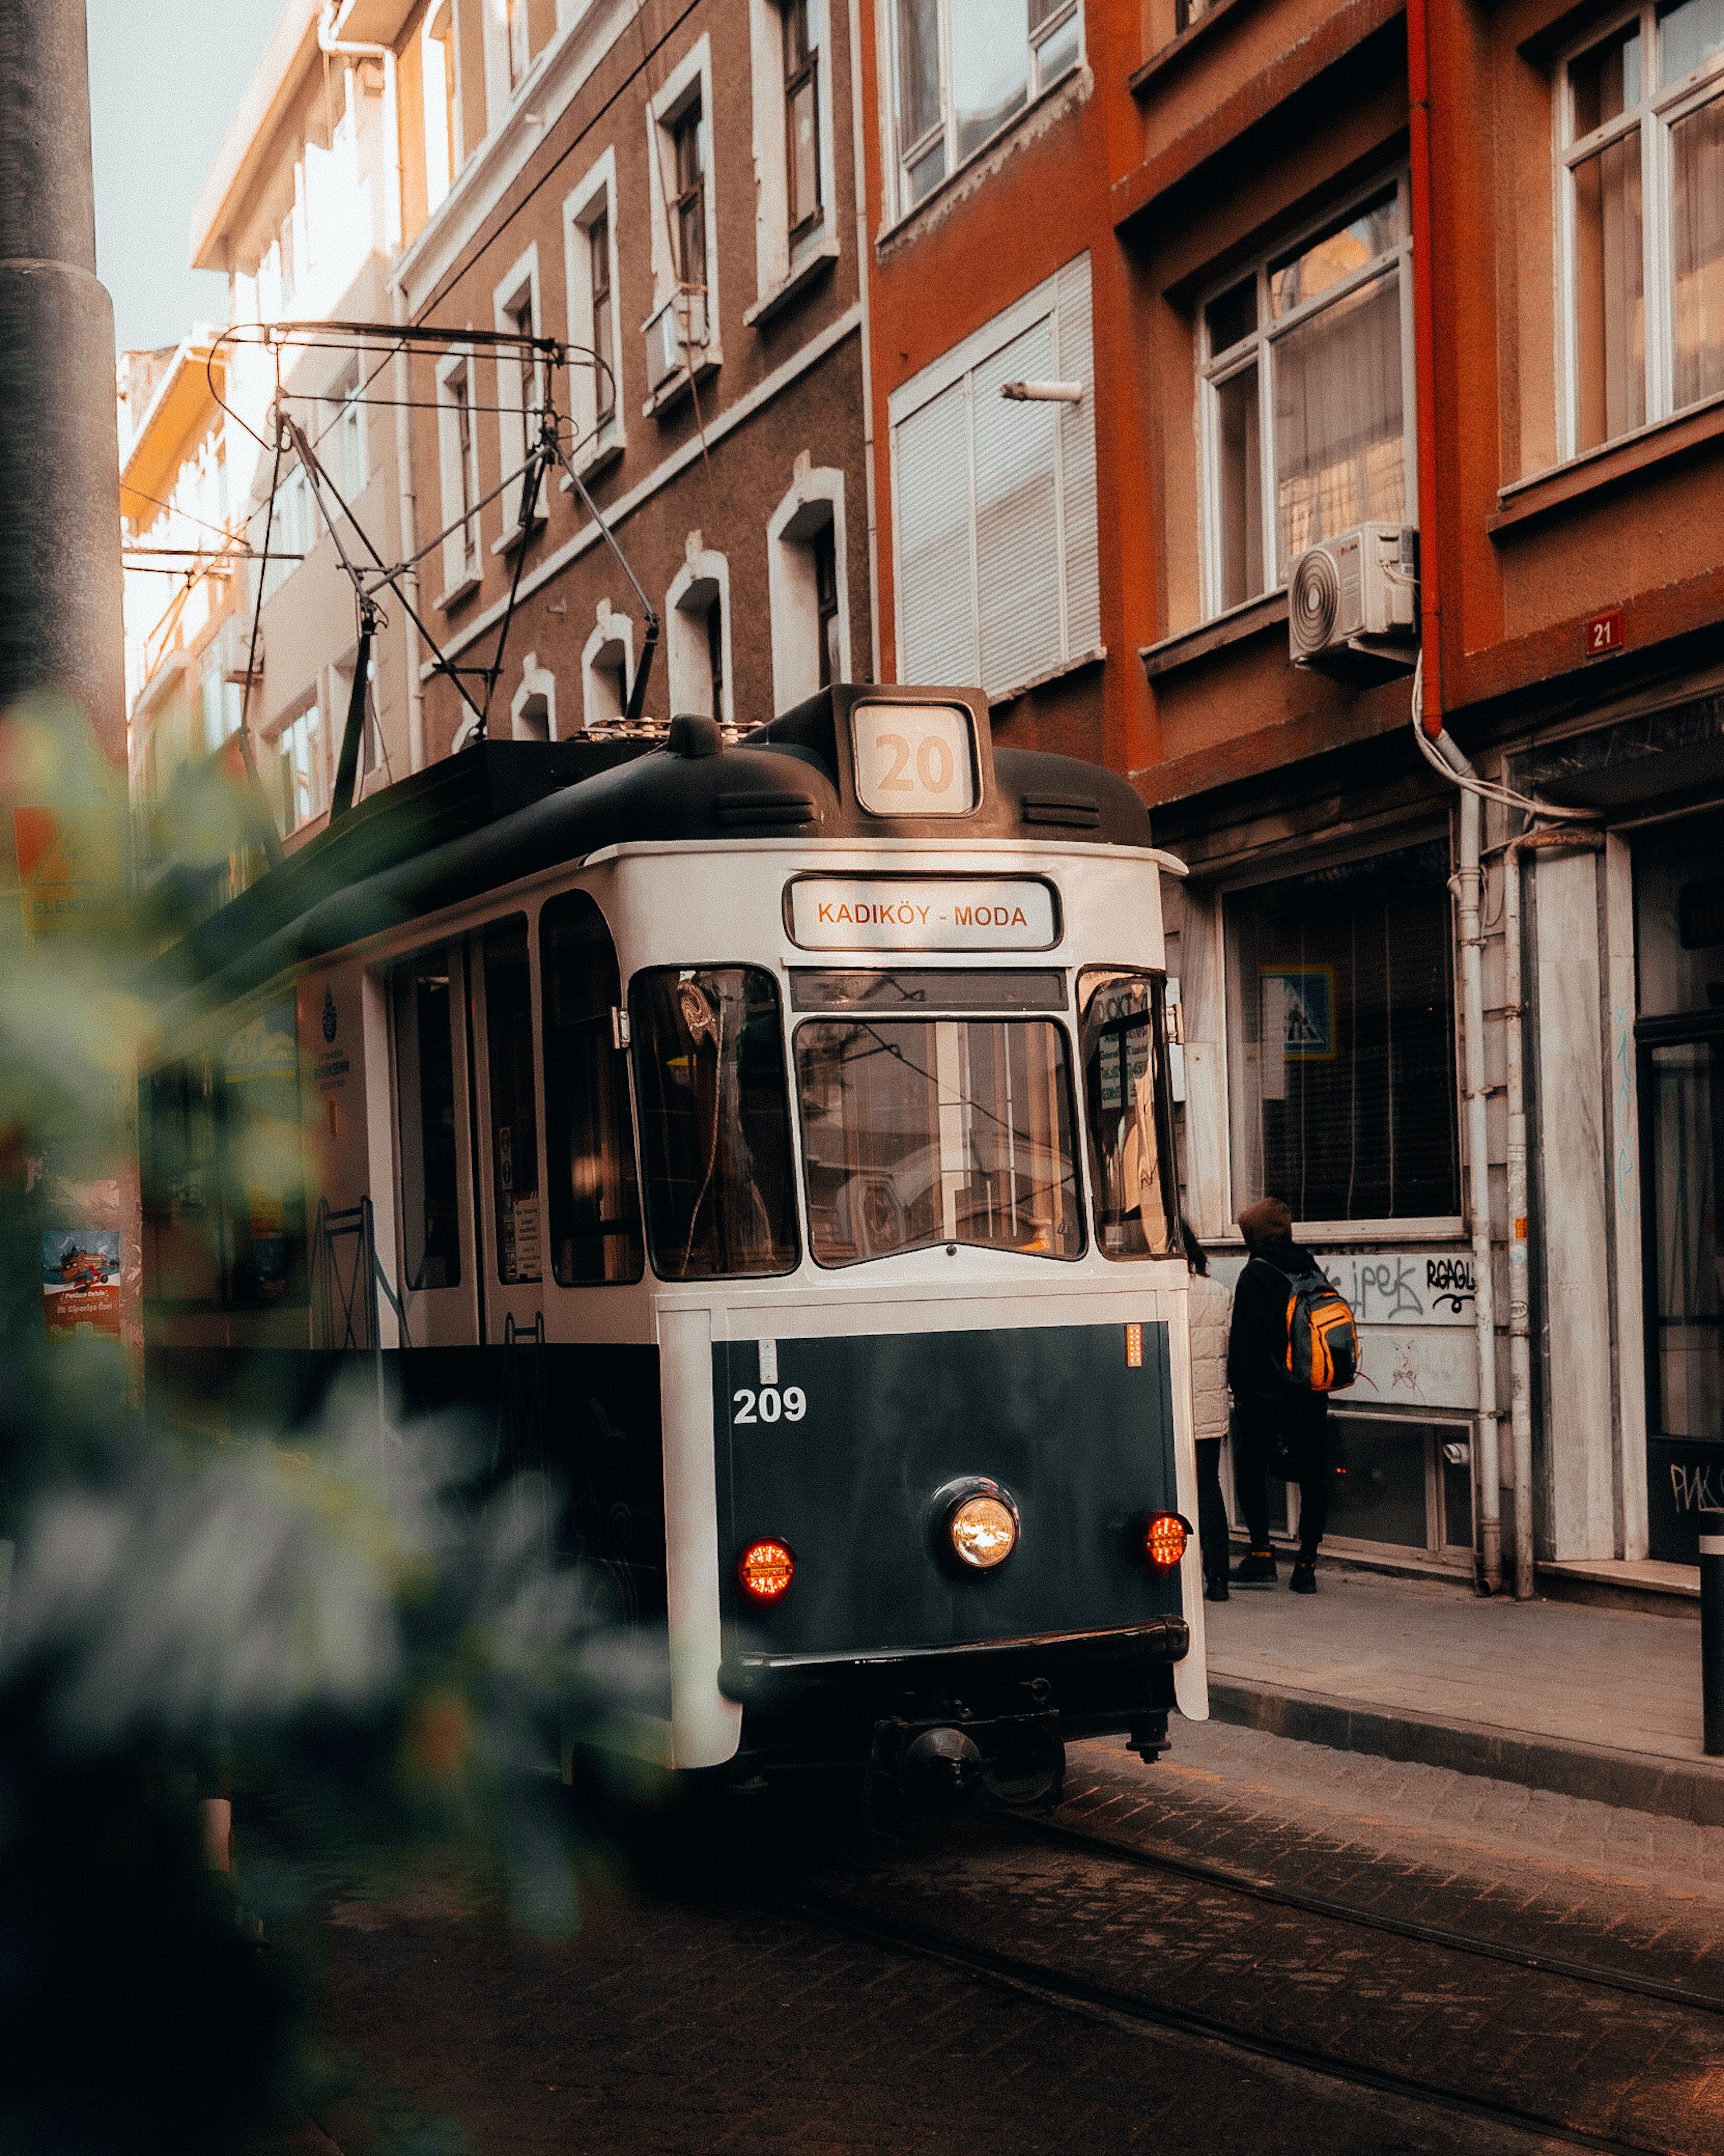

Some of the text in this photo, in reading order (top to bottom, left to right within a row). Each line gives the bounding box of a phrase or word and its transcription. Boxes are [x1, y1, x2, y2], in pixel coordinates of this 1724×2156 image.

[1594, 621, 1611, 647] 21
[875, 734, 954, 794] 20
[818, 901, 932, 926] KADIKÖY
[955, 906, 1028, 927] MODA
[733, 1386, 807, 1424] 209
